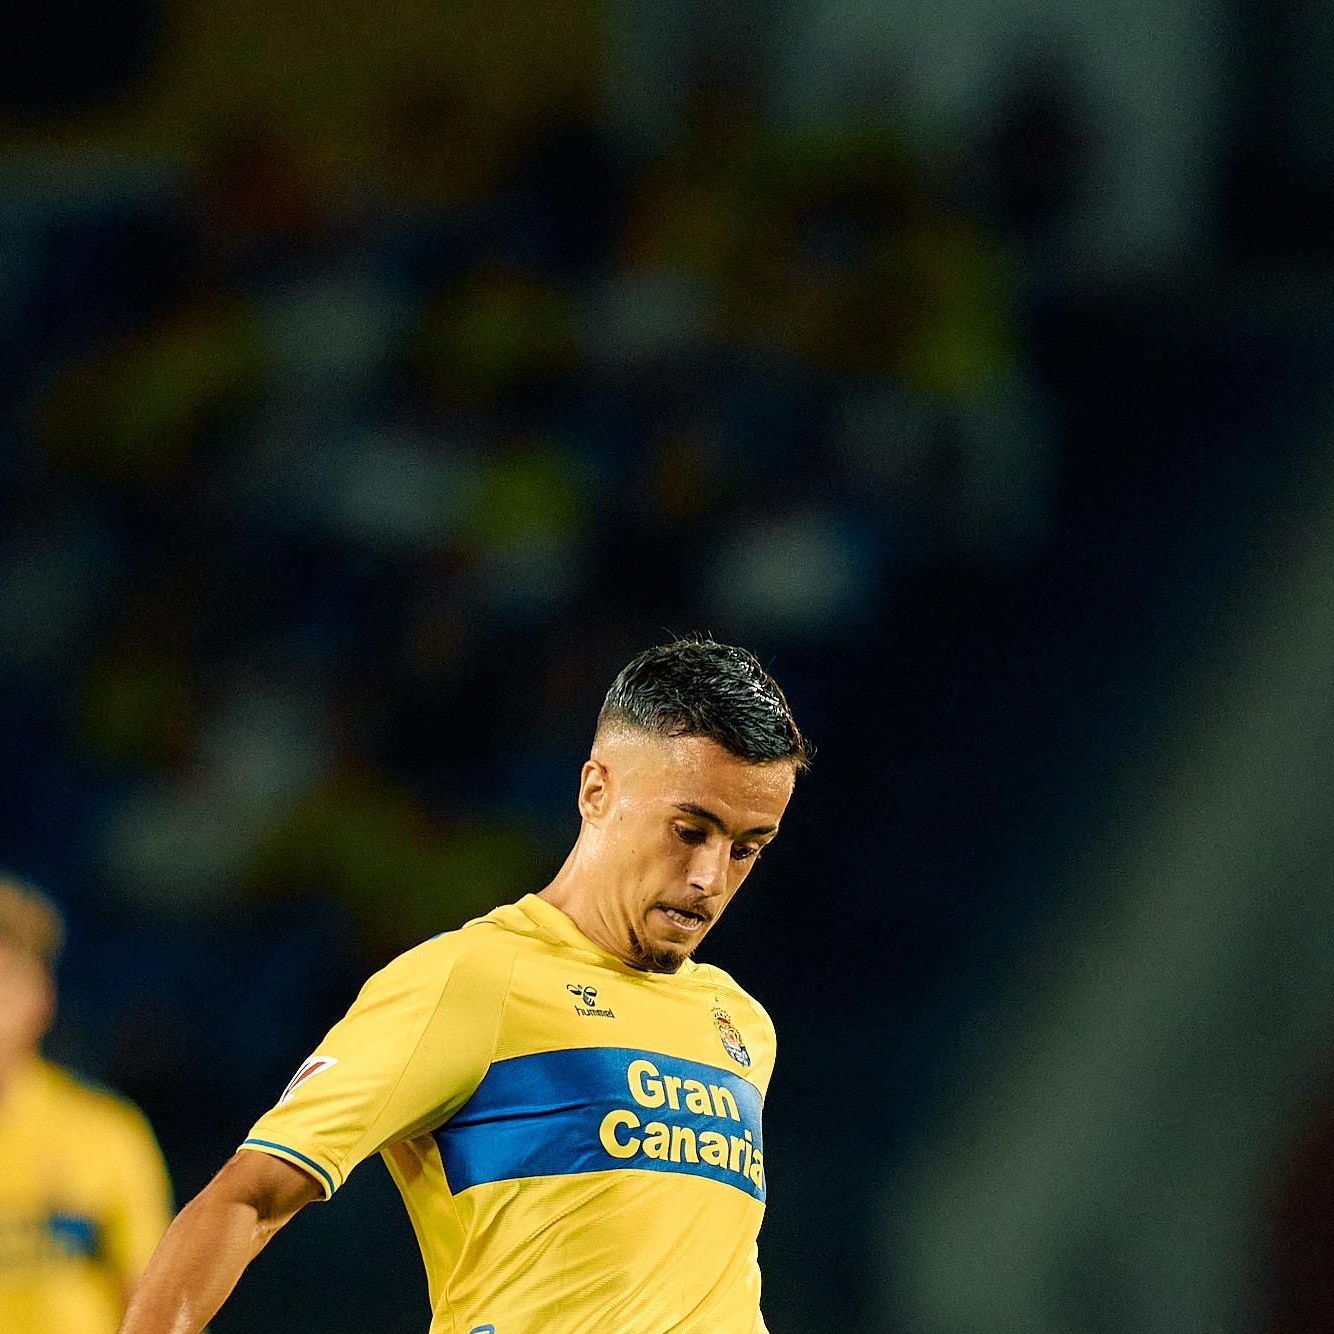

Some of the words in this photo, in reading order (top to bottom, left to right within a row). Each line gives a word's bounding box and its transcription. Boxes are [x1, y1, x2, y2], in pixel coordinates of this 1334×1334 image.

[574, 1004, 616, 1019] hummel
[626, 1058, 741, 1123] Gran
[598, 1108, 764, 1191] Canaria
